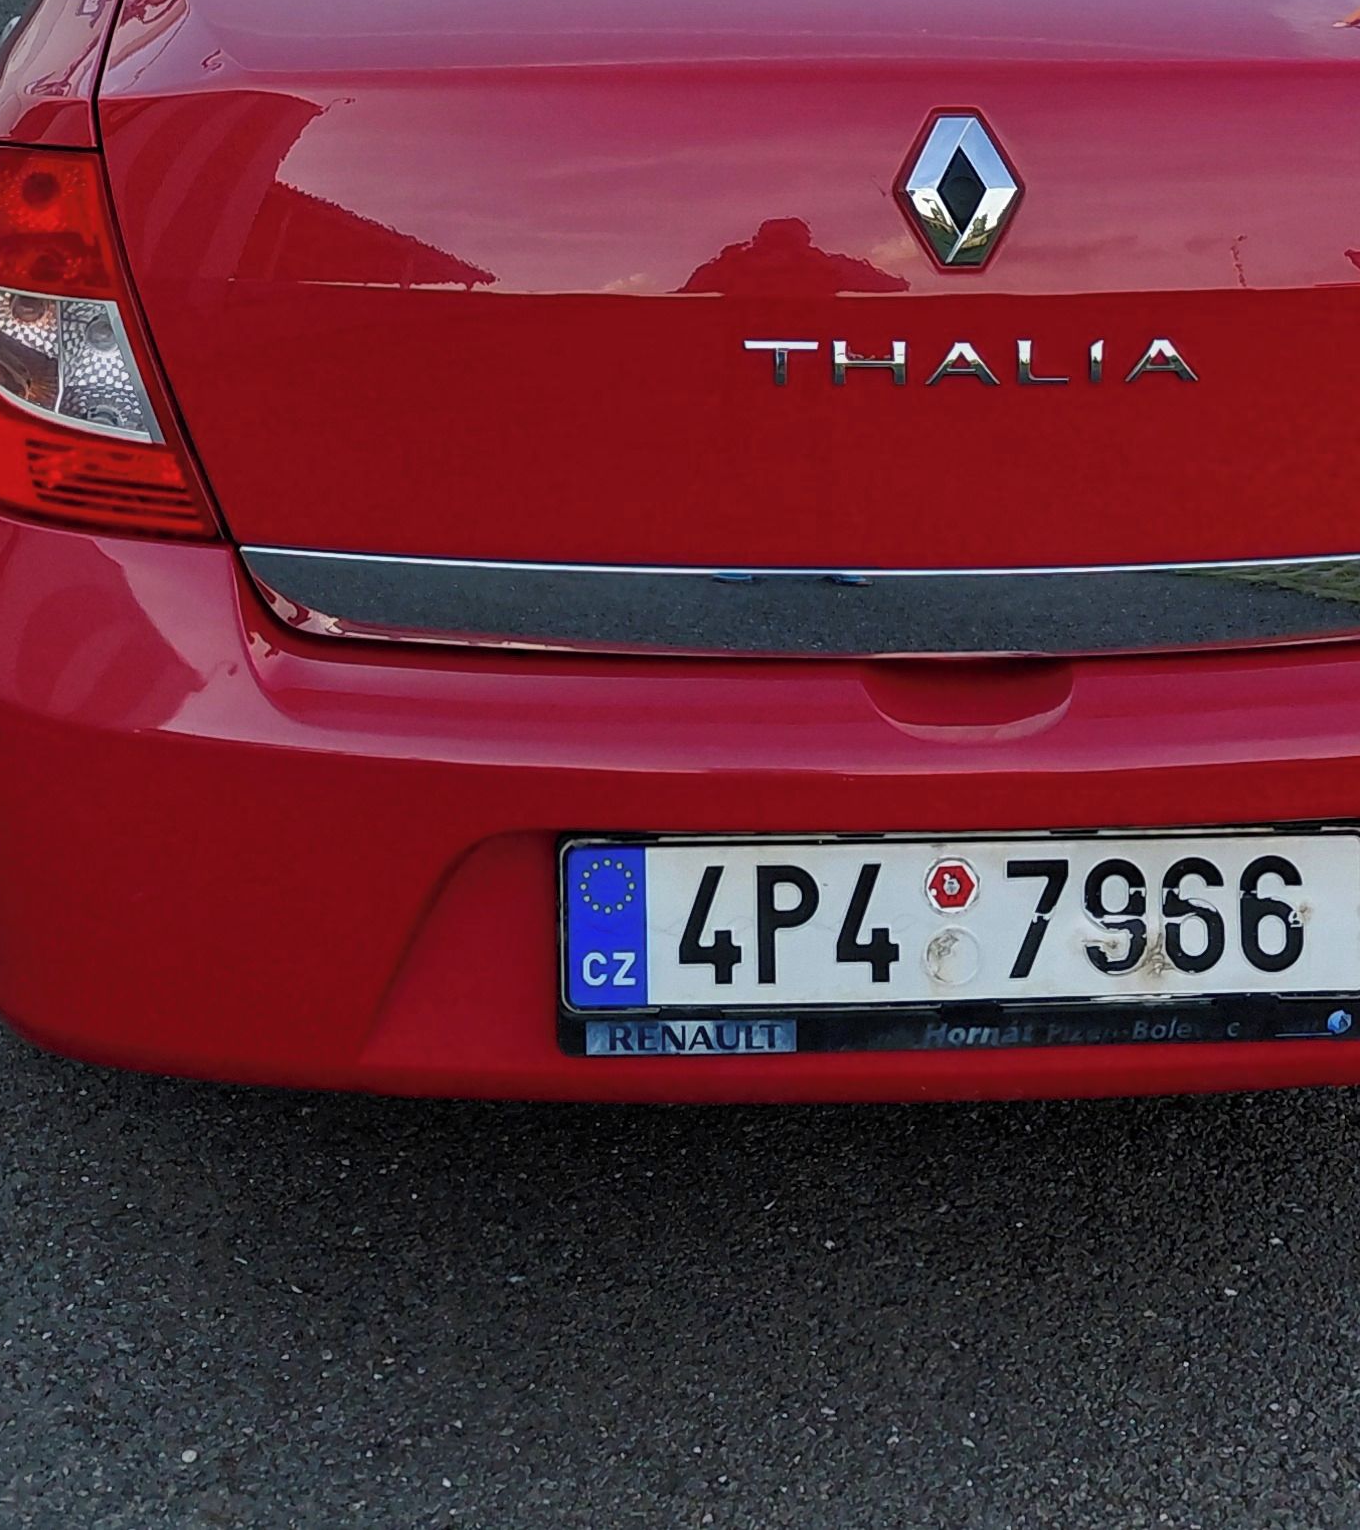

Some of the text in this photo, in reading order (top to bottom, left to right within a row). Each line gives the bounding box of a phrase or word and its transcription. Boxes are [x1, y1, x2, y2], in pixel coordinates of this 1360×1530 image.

[743, 338, 1199, 386] THALIA
[677, 854, 1304, 986] 4P4 7966
[581, 951, 637, 988] CZ
[607, 1023, 784, 1052] RENAULT
